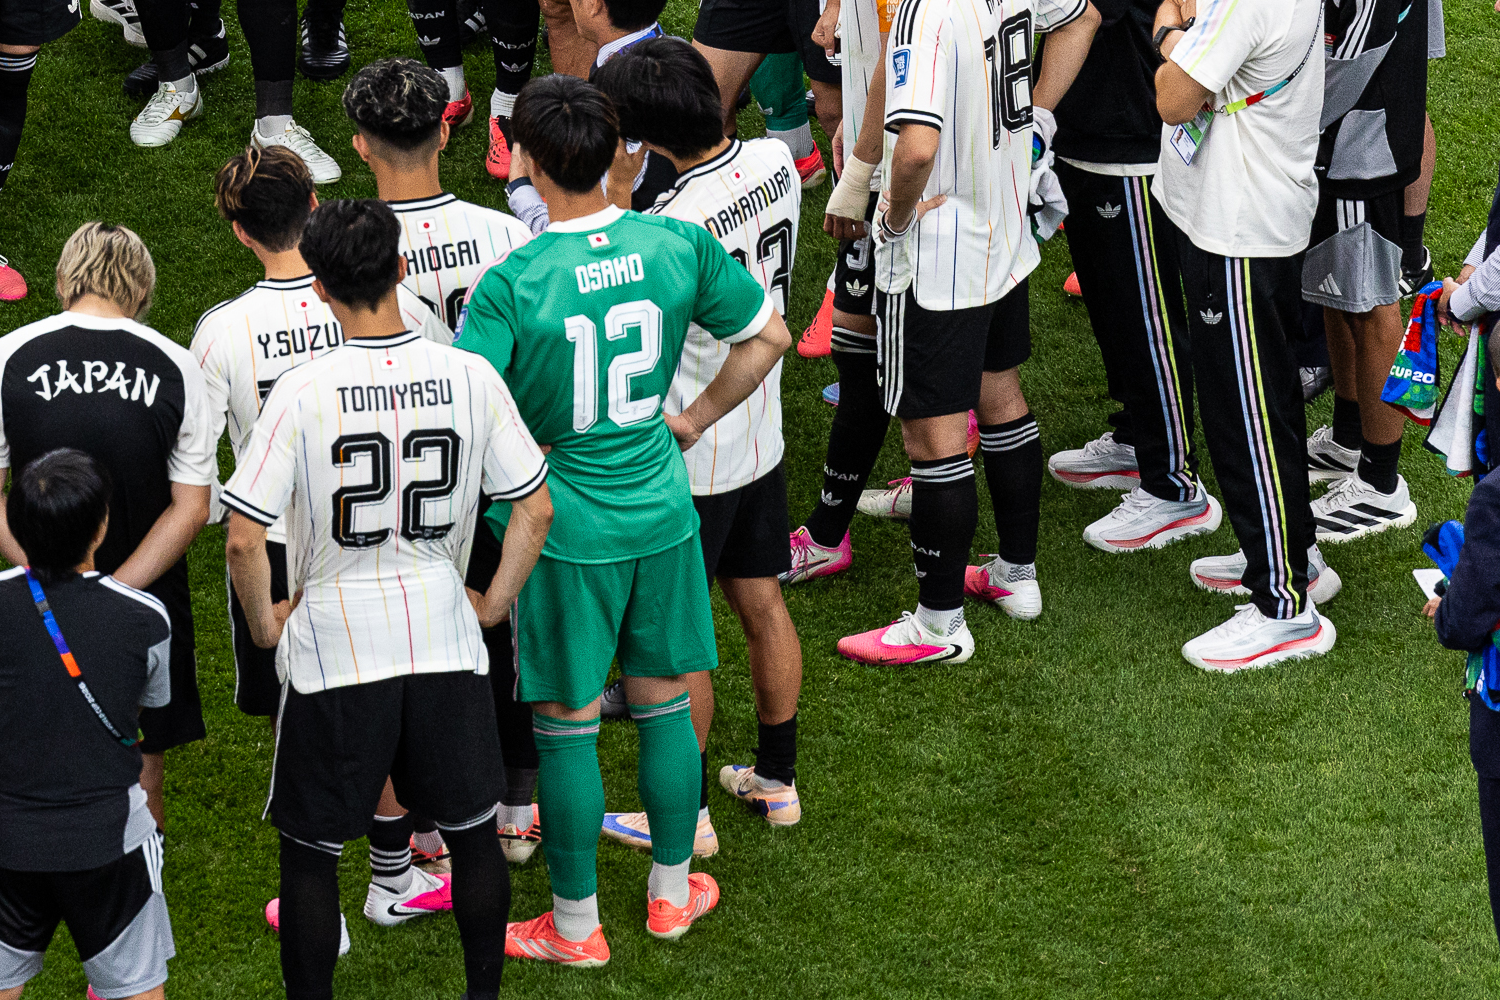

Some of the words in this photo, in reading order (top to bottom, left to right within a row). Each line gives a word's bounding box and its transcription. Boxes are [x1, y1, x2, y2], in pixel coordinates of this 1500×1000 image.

[984, 8, 1034, 150] 18
[704, 165, 792, 239] NAKAMURA
[405, 239, 481, 276] HIOGAI
[575, 252, 644, 293] OSAKO
[257, 321, 339, 359] Y.SUZU
[27, 360, 161, 408] JAPAN
[563, 298, 663, 432] 12
[1389, 363, 1412, 379] CUP
[1411, 369, 1435, 385] 20
[337, 378, 453, 413] TOMIYASU
[331, 426, 464, 550] 22
